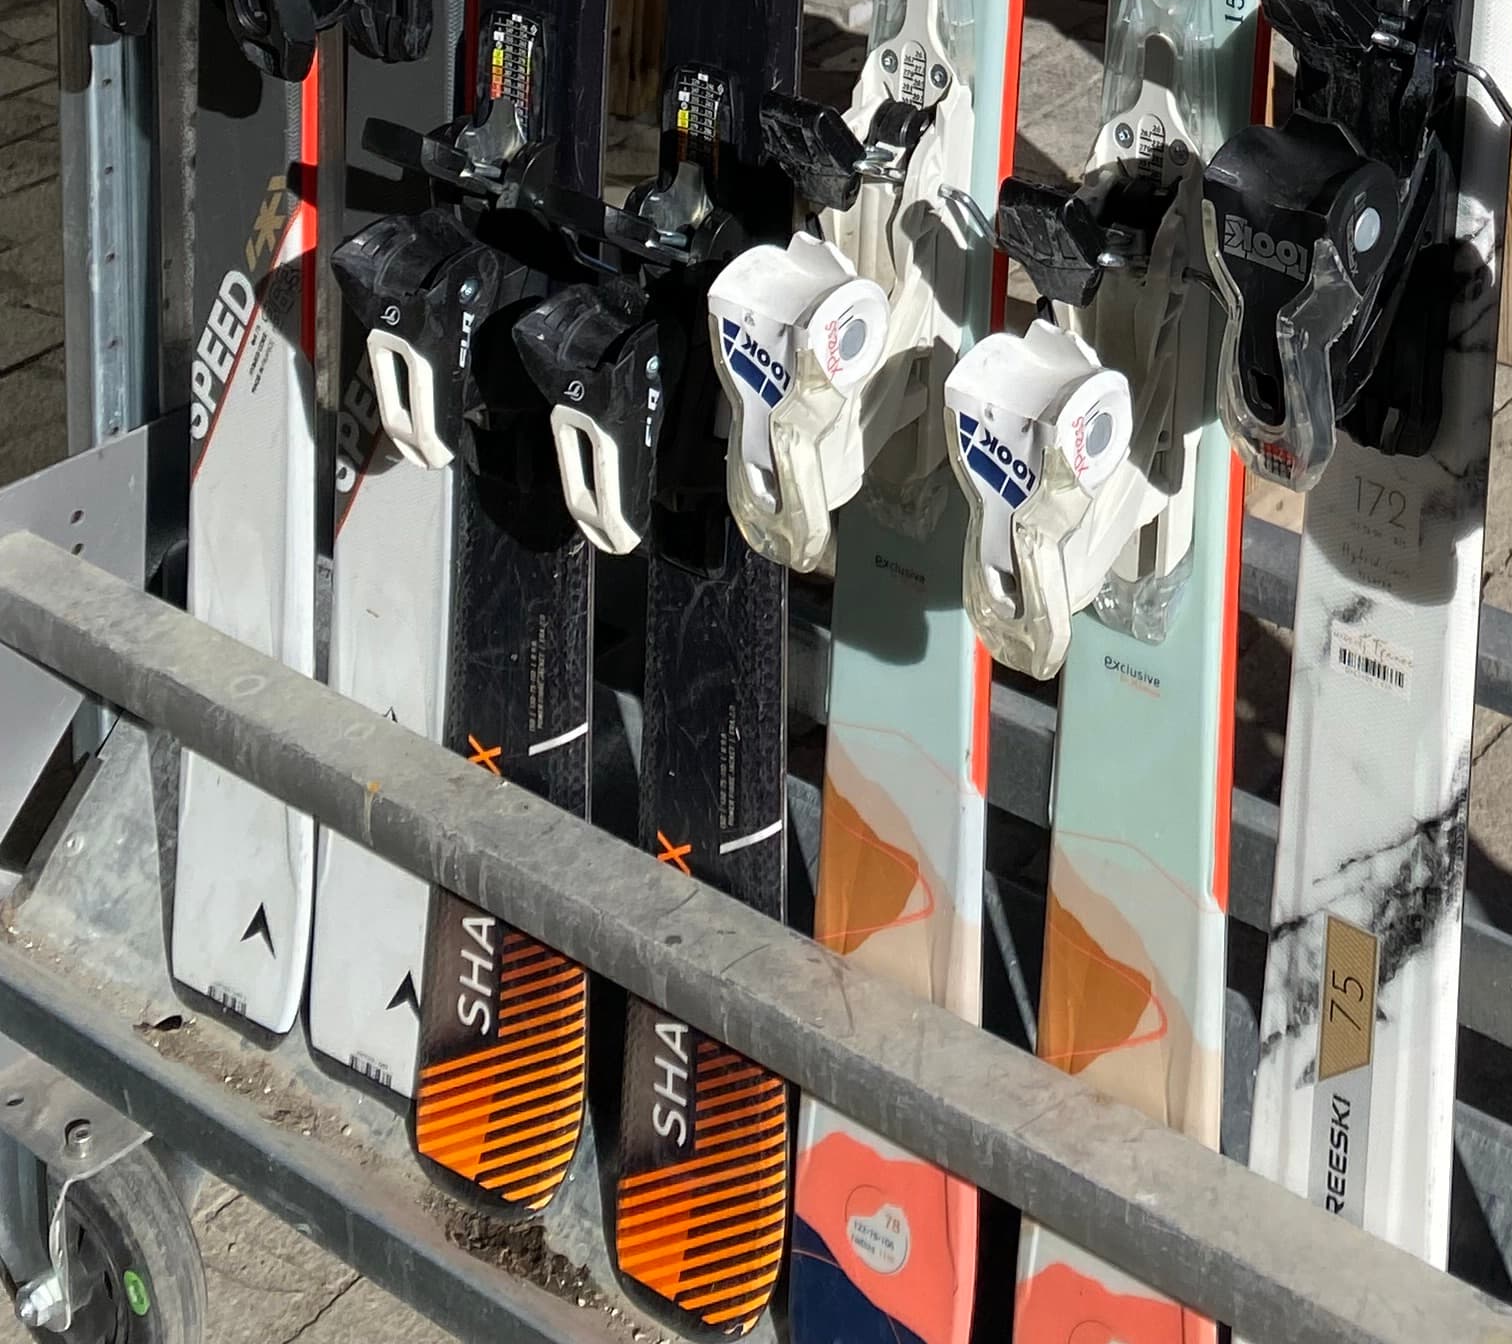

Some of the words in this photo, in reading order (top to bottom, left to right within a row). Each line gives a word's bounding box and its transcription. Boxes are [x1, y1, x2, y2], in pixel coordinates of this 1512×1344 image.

[1224, 216, 1308, 277] LOOK
[190, 269, 256, 440] SPEED
[740, 332, 792, 392] LOOK
[979, 427, 1037, 492] LOOK
[1354, 475, 1406, 529] 172
[875, 554, 926, 585] exclusive
[1104, 655, 1161, 688] exclusive
[1329, 968, 1366, 1033] 75
[1325, 1095, 1352, 1213] REESKI
[885, 1213, 900, 1234] 78
